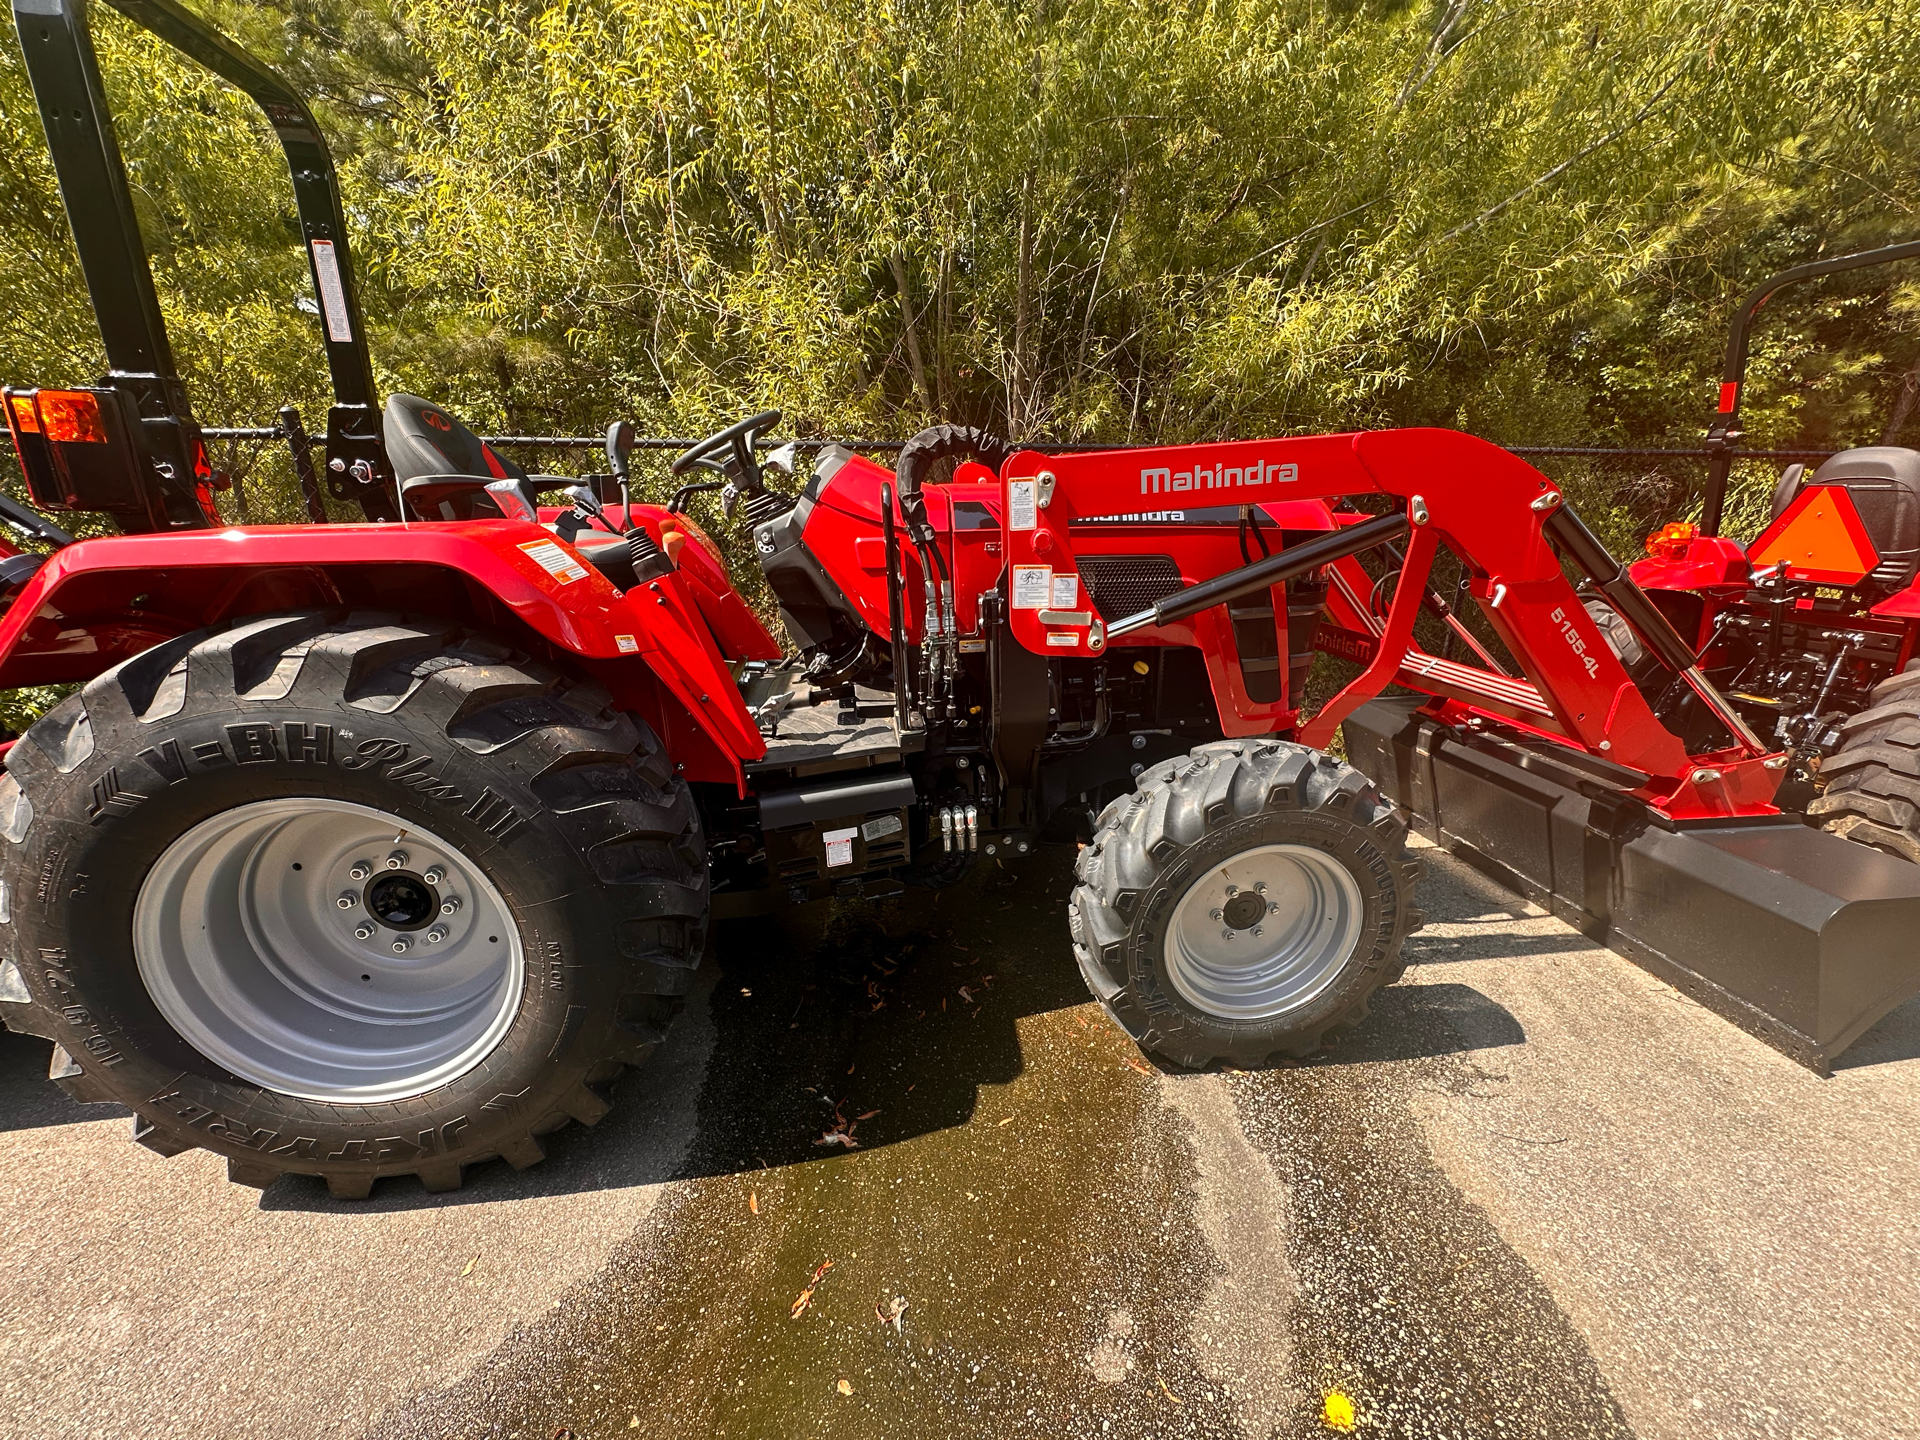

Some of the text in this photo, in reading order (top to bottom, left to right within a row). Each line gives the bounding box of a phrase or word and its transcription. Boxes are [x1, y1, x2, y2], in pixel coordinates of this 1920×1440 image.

[1141, 460, 1298, 494] Mahindra
[1550, 607, 1599, 679] 5155-4L
[136, 722, 333, 785] V-BH
[341, 738, 465, 802] Plus
[1354, 839, 1397, 976] INDUSTRIAL
[547, 940, 563, 992] NYLON
